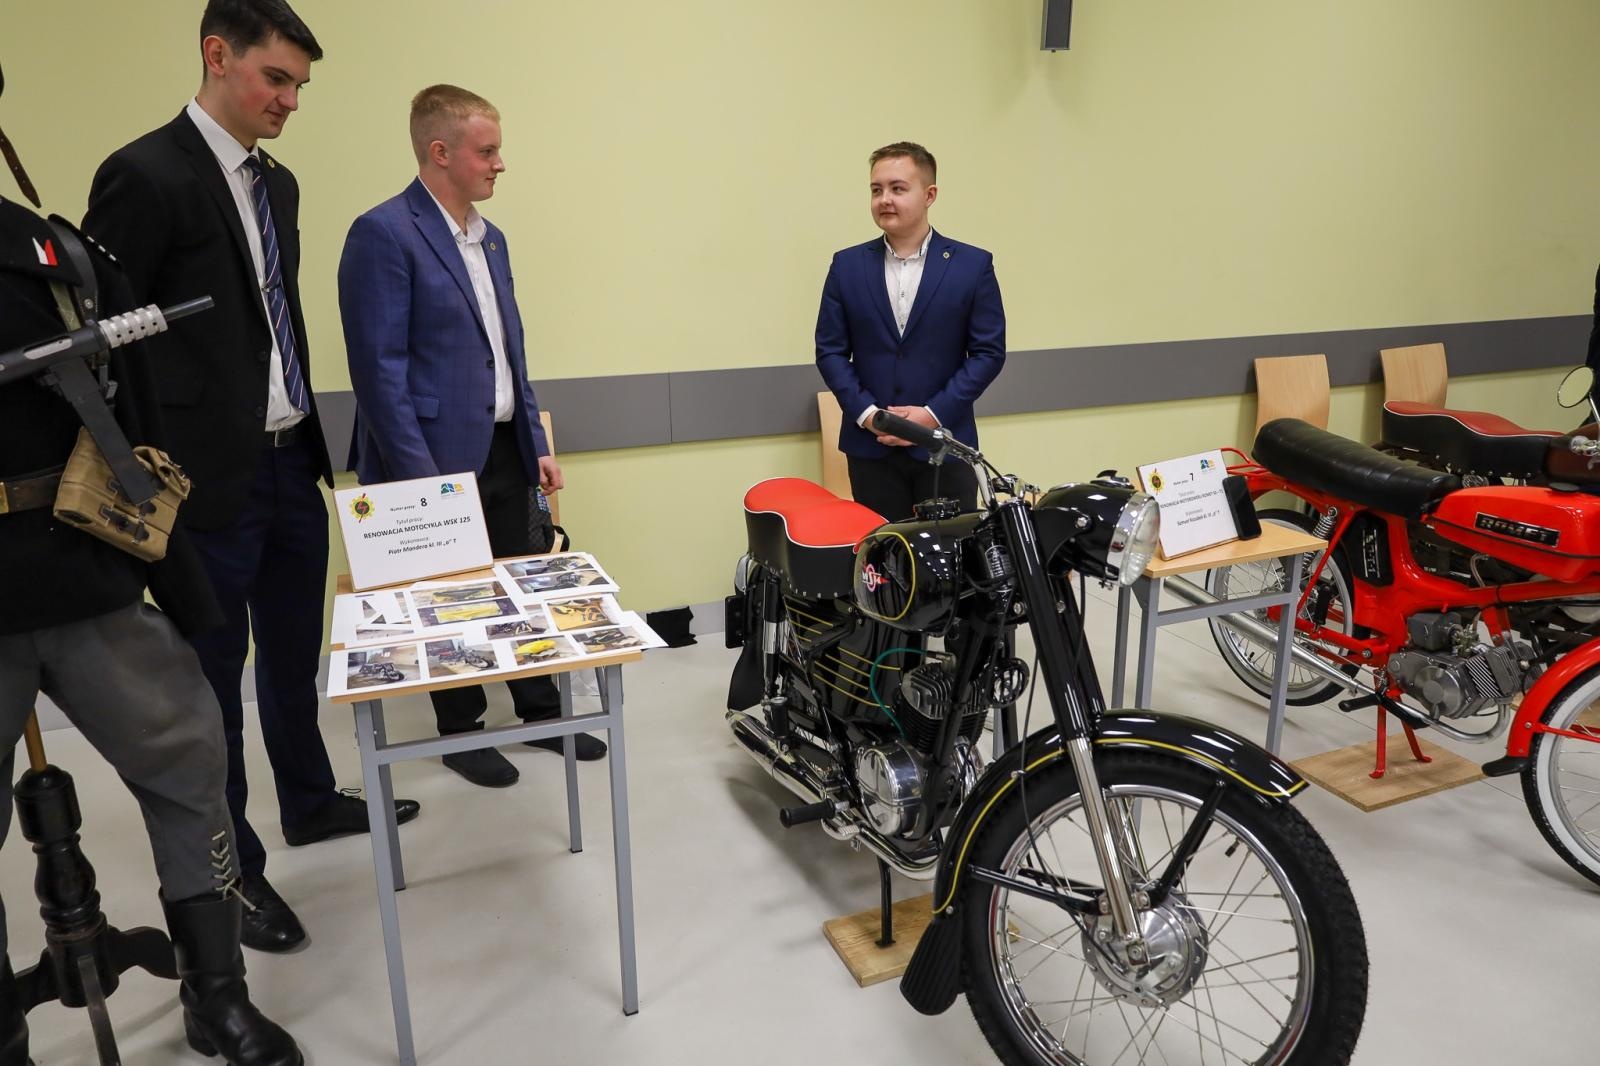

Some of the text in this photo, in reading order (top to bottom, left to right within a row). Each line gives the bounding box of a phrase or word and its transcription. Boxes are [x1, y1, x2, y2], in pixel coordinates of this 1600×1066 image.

[1189, 472, 1194, 481] 7
[420, 497, 428, 507] 8
[363, 515, 471, 539] RENOWACJA MOTOCYKLA WSK 125
